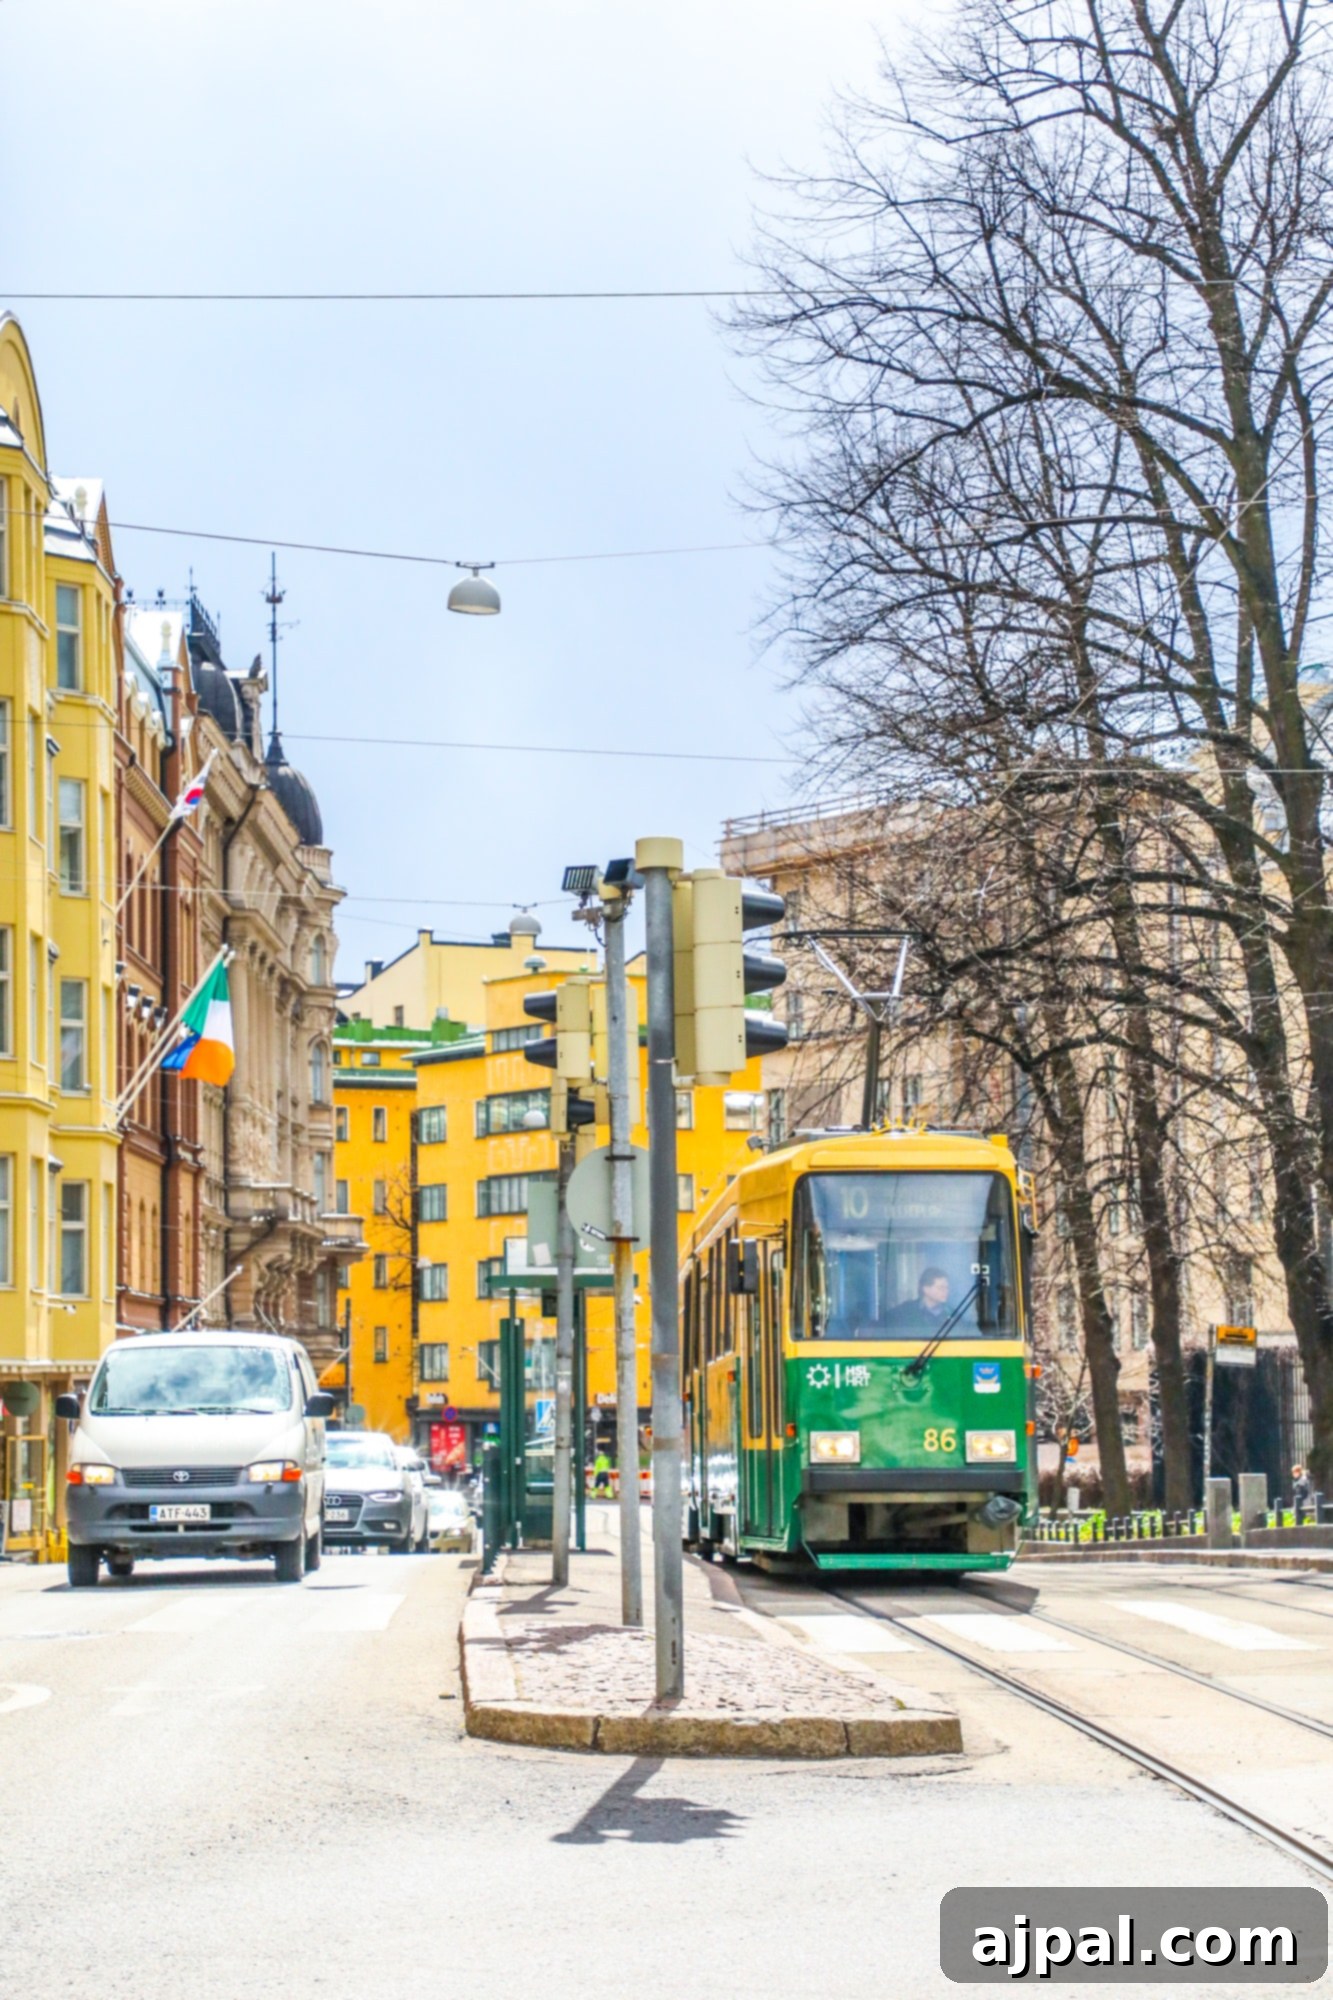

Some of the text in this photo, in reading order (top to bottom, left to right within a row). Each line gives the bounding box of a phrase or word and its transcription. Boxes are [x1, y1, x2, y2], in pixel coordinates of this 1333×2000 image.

[841, 1185, 869, 1219] 10
[845, 1365, 871, 1376] HSL
[923, 1428, 956, 1453] 86
[160, 1507, 208, 1519] ATF-443
